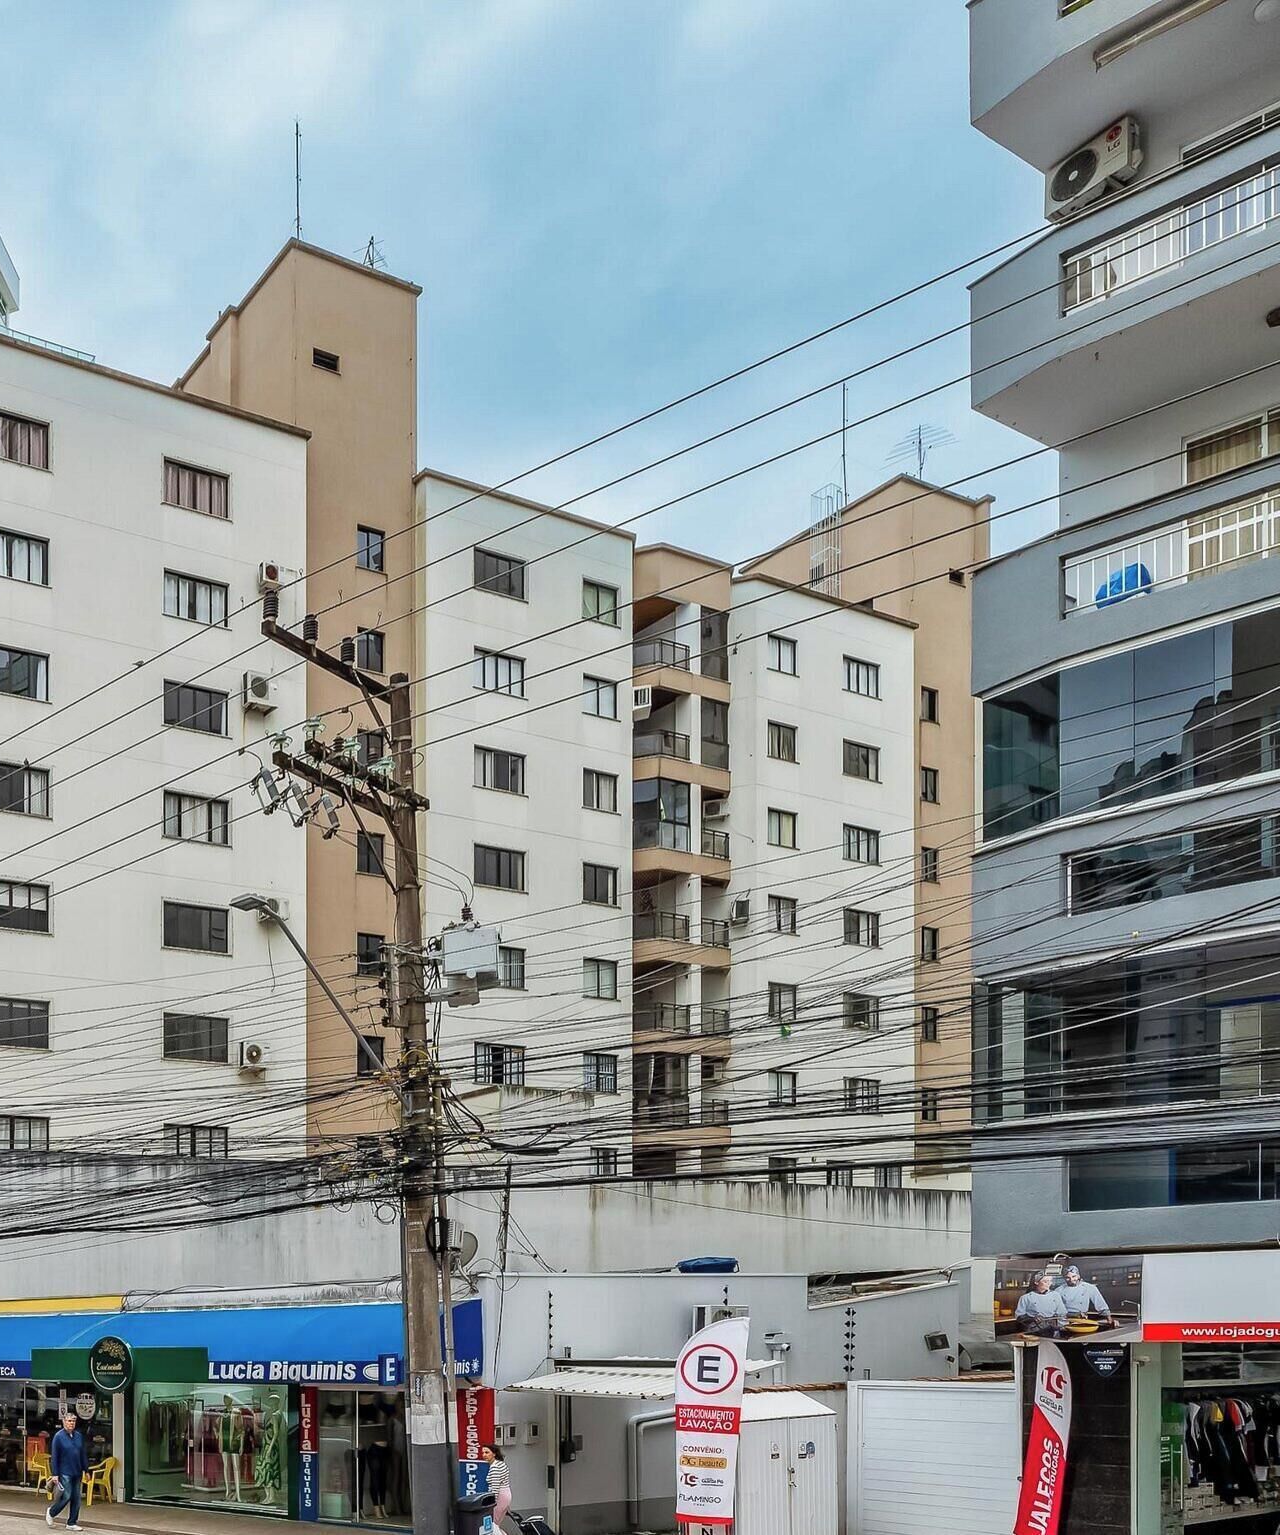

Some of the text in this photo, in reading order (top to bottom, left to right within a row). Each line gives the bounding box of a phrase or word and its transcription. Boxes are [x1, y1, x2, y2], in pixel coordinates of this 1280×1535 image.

[1107, 139, 1121, 152] LG
[208, 1360, 357, 1382] Lucia Biquinis
[385, 1357, 396, 1381] E
[697, 1356, 720, 1384] E
[301, 1394, 311, 1451] Lucia
[678, 1407, 735, 1421] ESTACIONAMENTO
[679, 1419, 733, 1432] LAVAÇÃO
[1028, 1437, 1053, 1535] JALECOS
[678, 1493, 722, 1504] FLAMINGO
